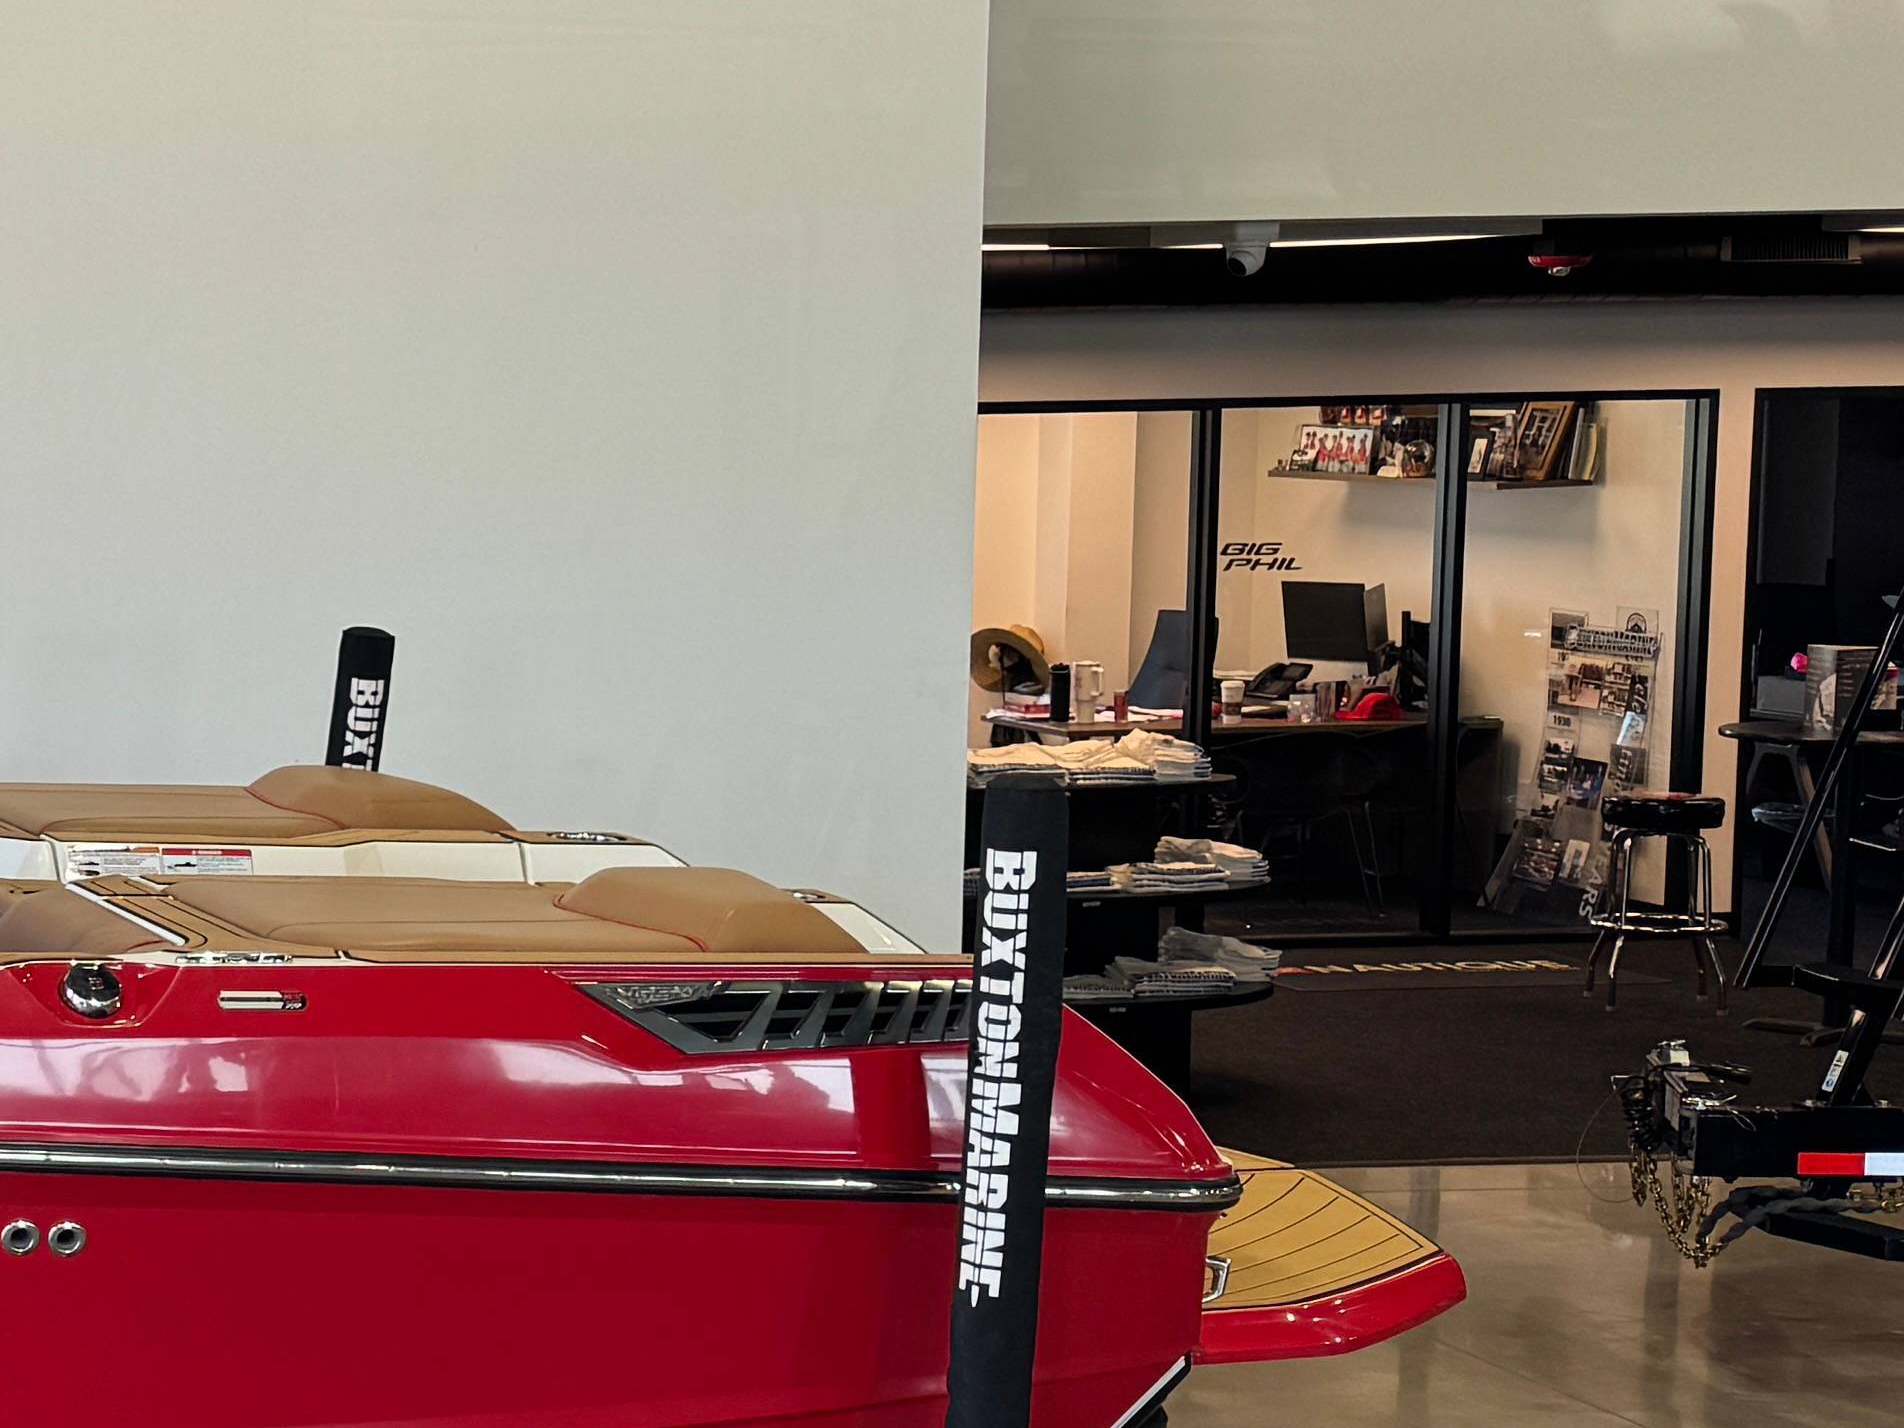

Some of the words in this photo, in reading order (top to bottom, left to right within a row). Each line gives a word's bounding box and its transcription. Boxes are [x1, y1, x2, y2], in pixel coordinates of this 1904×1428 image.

[1220, 542, 1283, 556] BIG
[1223, 557, 1303, 572] PHIL
[958, 847, 1039, 1299] BUXTONMARINE
